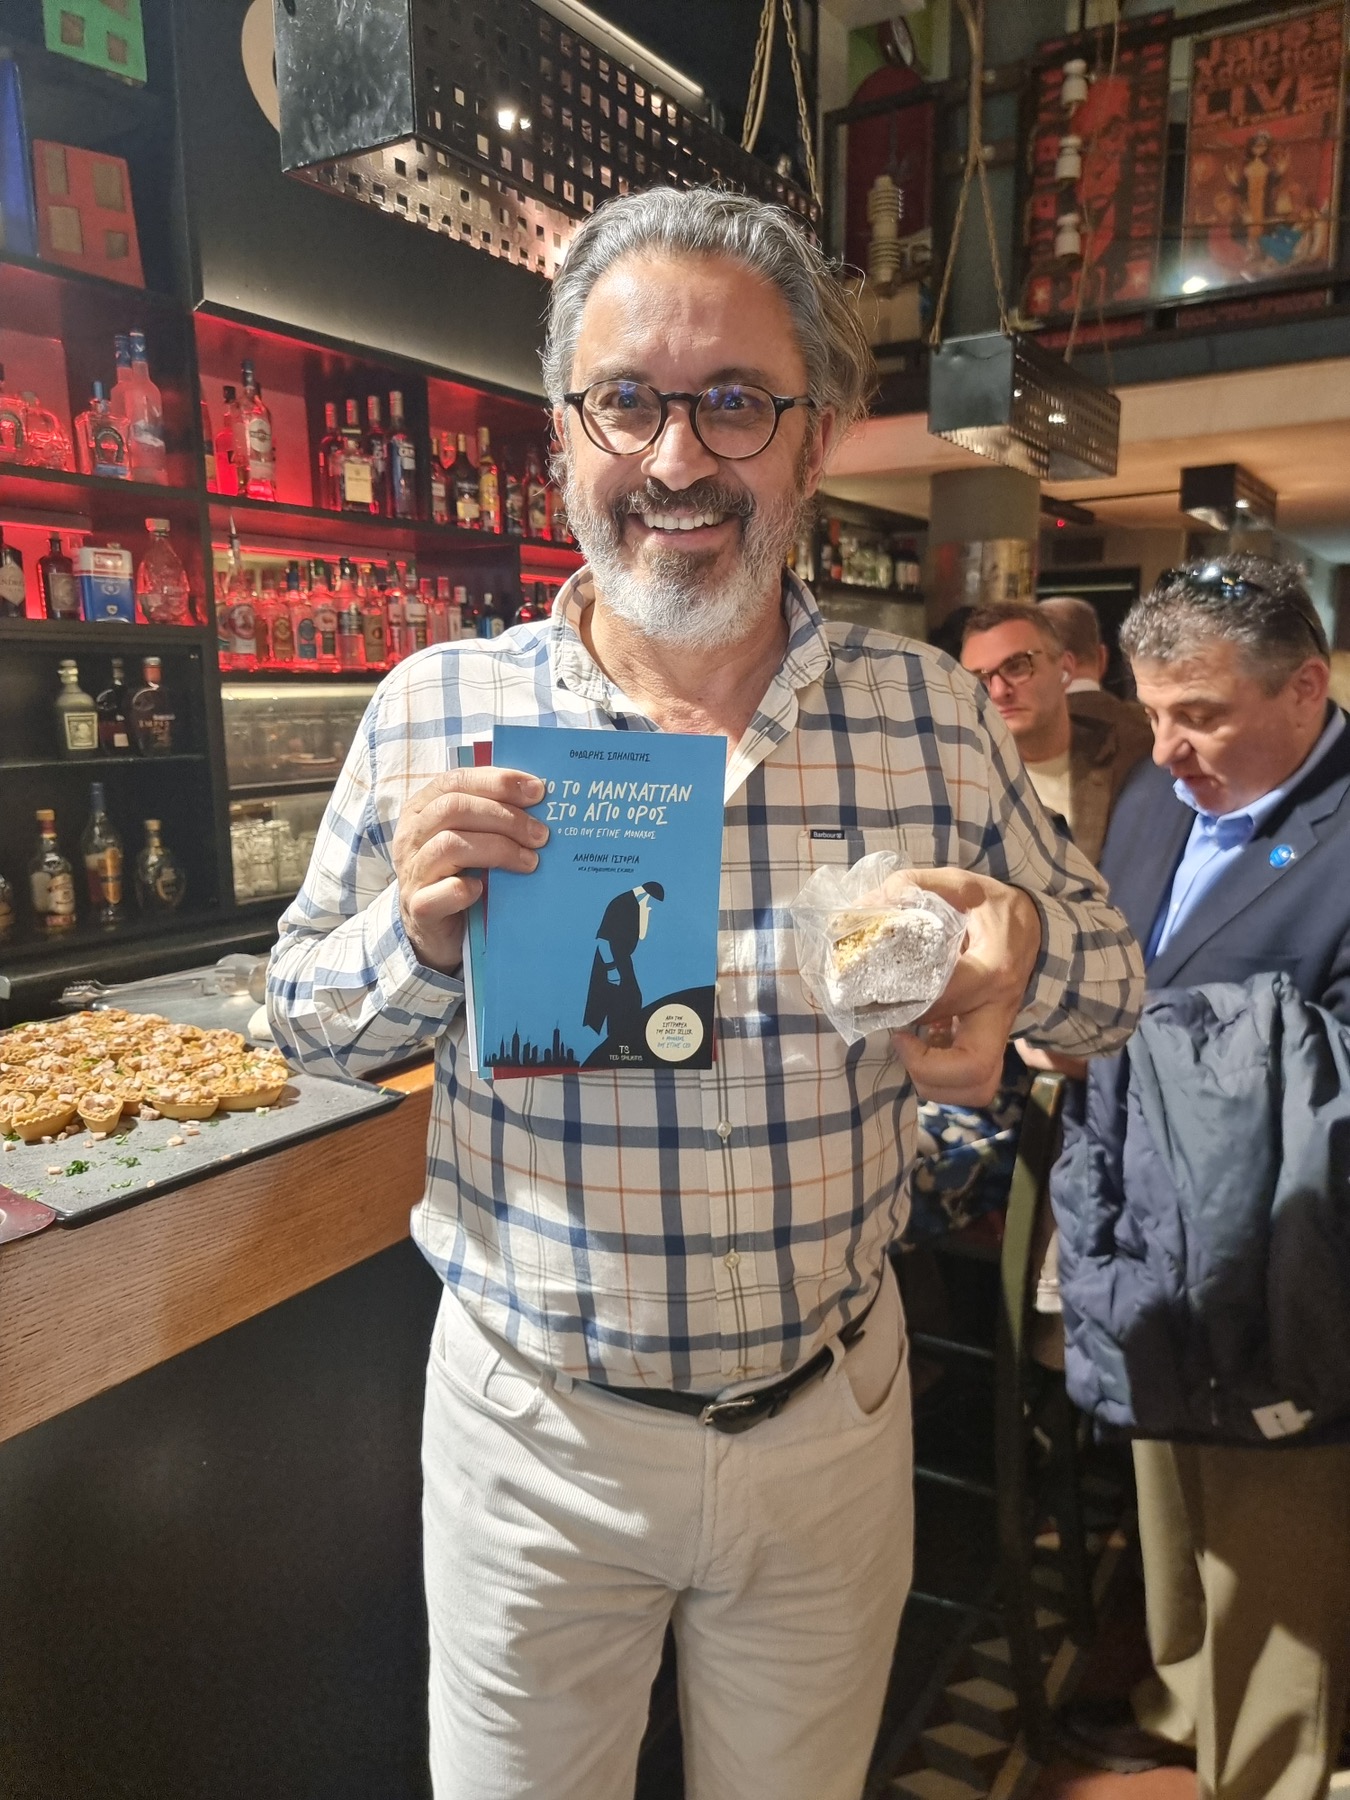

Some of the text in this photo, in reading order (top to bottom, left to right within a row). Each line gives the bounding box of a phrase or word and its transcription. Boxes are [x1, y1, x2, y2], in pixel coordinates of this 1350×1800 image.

[1193, 74, 1337, 125] LIVE
[569, 749, 651, 762] ΘΟΔΩΡΗΣ ΣΠΗΛΙΩΤΗΣ
[562, 780, 581, 798] ΤΟ
[587, 781, 693, 803] ΜΑΝΧΑΤΤΑΝ
[546, 801, 668, 825] ΣΤΟ ΑΓΙΟ ΟΡΟΣ
[564, 827, 578, 836] CEO
[580, 828, 595, 838] ΠΟΥ
[596, 828, 622, 839] ΕΓΙΝΕ
[623, 829, 656, 840] ΜΟΝΑΧΟΣ
[572, 853, 640, 864] ΑΛΗΘΙΝΗ ΙΣΤΟΡΙΑ
[619, 1045, 630, 1054] TS
